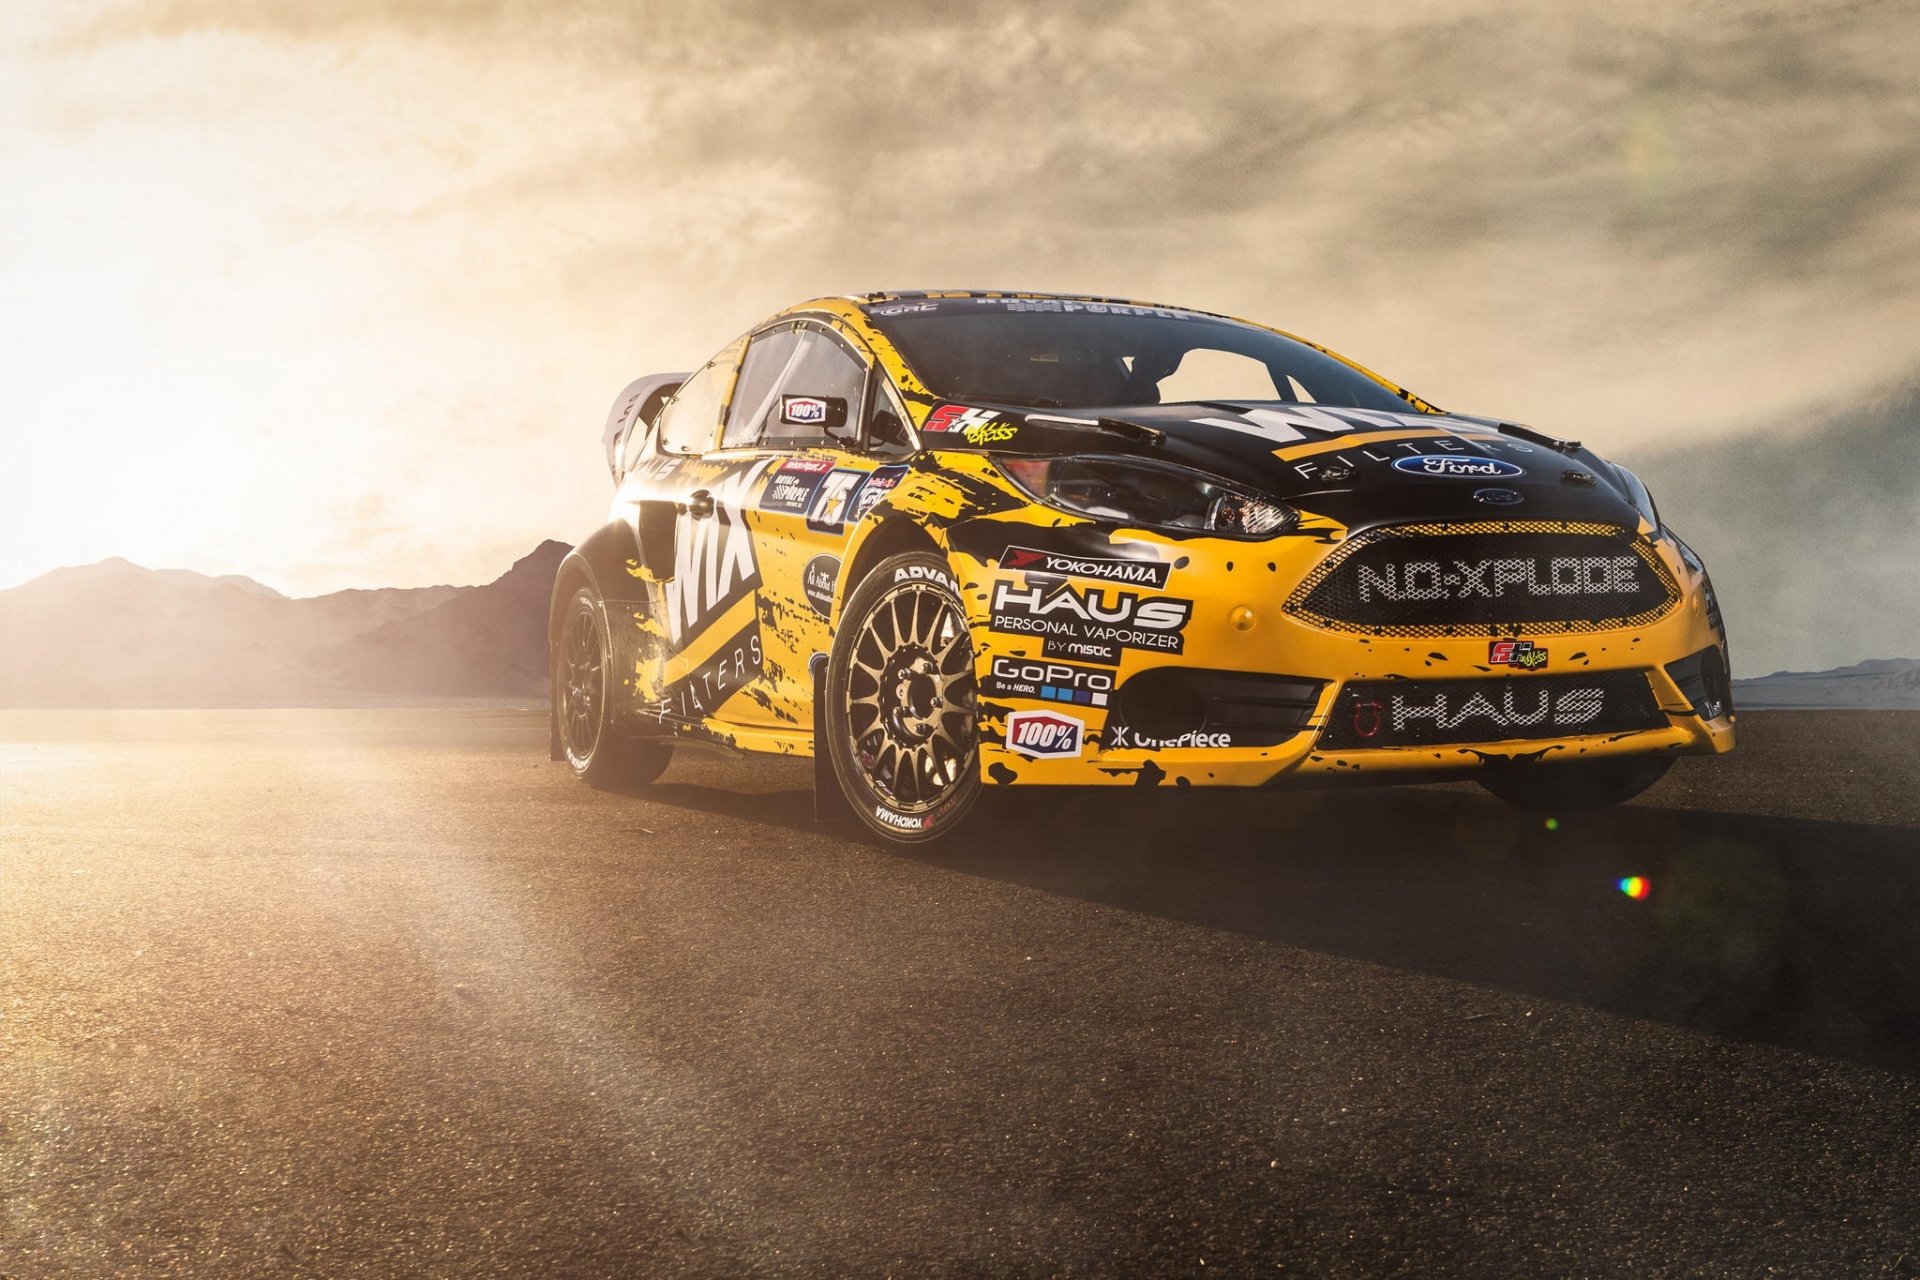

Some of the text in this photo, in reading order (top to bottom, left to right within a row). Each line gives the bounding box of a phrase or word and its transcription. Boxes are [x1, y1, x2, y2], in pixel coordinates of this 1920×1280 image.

[791, 404, 820, 417] 100%
[1293, 439, 1533, 479] FILTERS
[1422, 458, 1502, 475] Ford
[1046, 557, 1159, 583] YOKOHAMA
[994, 585, 1187, 629] HAUS
[994, 615, 1179, 649] PERSONAL VAPORIZER
[1048, 640, 1067, 651] BY
[658, 635, 762, 724] FILTERS
[993, 659, 1111, 691] GoPro
[996, 681, 1006, 690] Be
[1013, 683, 1036, 694] HERO.
[1392, 688, 1605, 731] HAUS
[1017, 722, 1074, 750] 100%
[875, 806, 922, 829] YOKOHAMA
